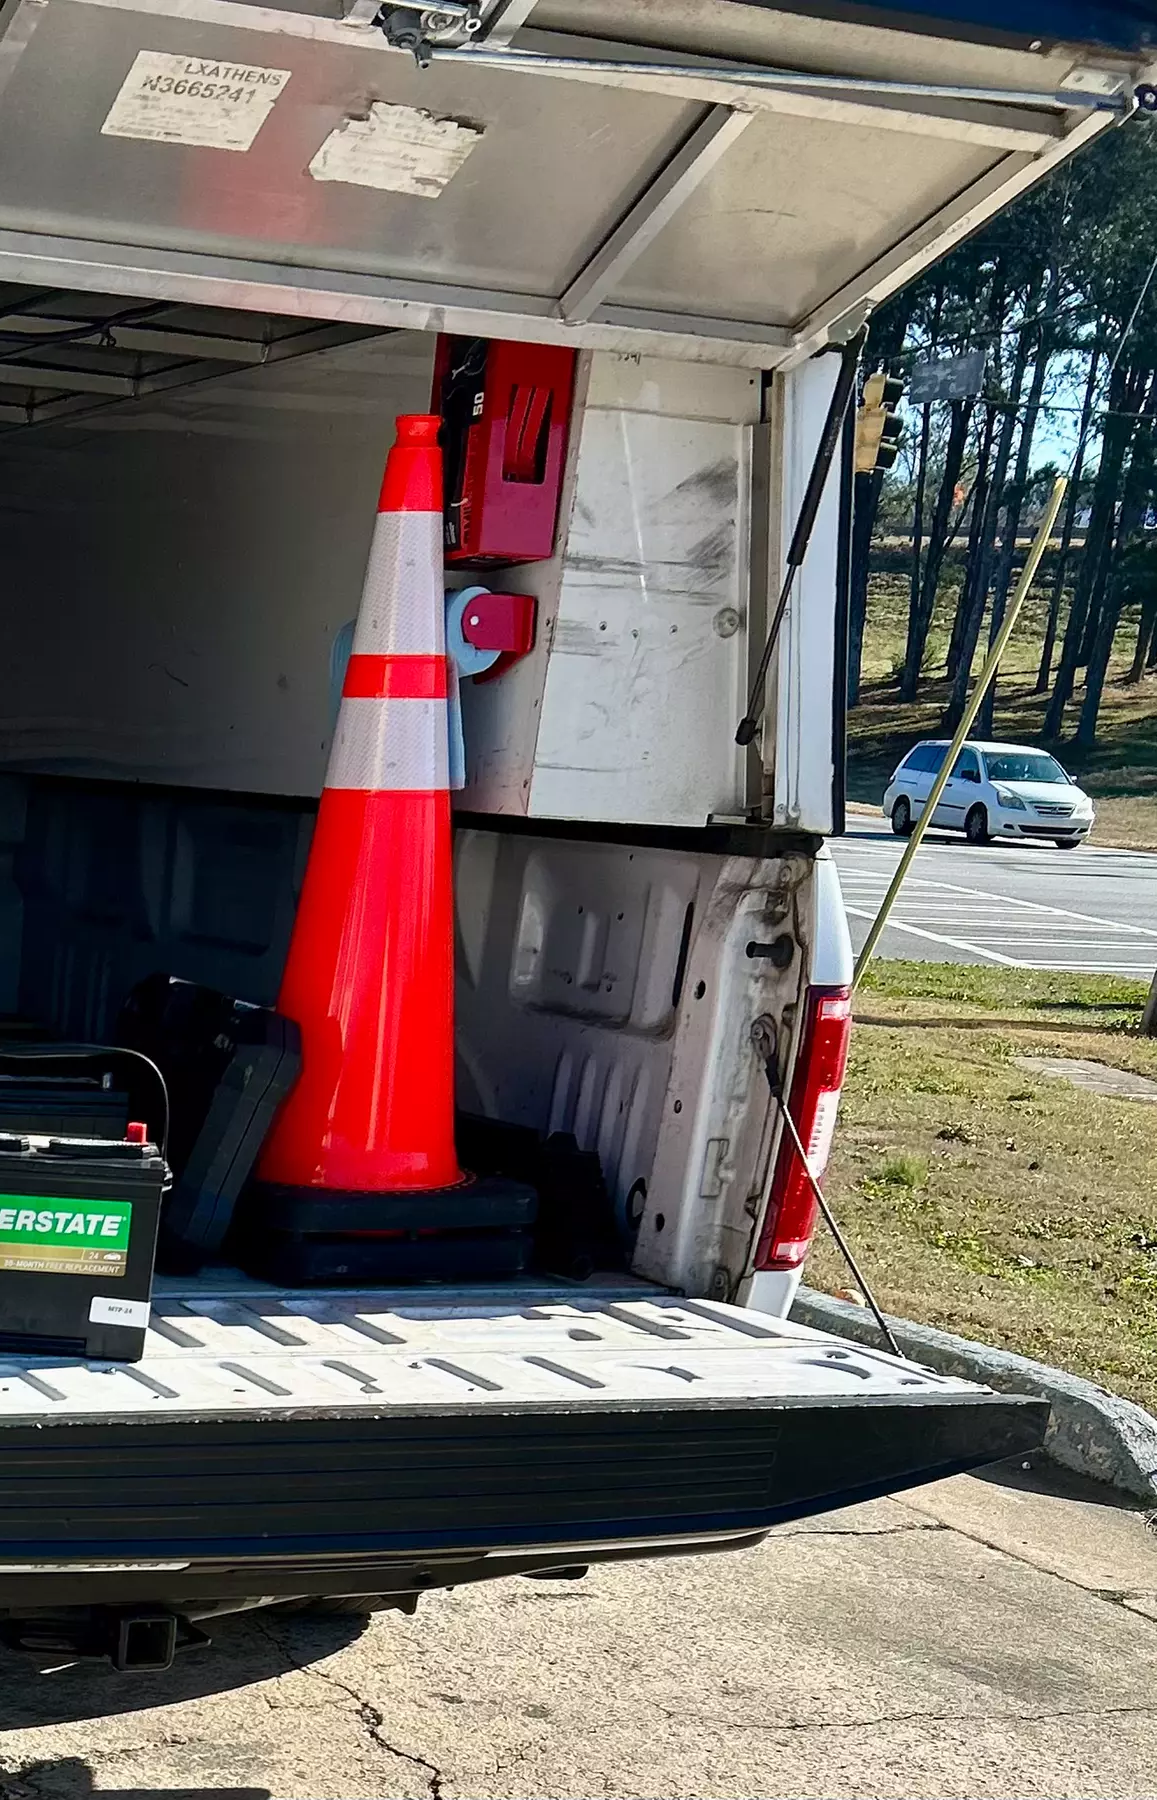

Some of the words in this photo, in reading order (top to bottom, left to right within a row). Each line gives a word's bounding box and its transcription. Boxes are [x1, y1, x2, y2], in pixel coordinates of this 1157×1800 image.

[184, 62, 283, 86] LXATHENS
[141, 75, 257, 104] N3665241
[472, 392, 484, 416] 50
[45, 1261, 65, 1270] FREE
[65, 1262, 121, 1274] REPLACEMENT
[88, 1251, 100, 1260] 24
